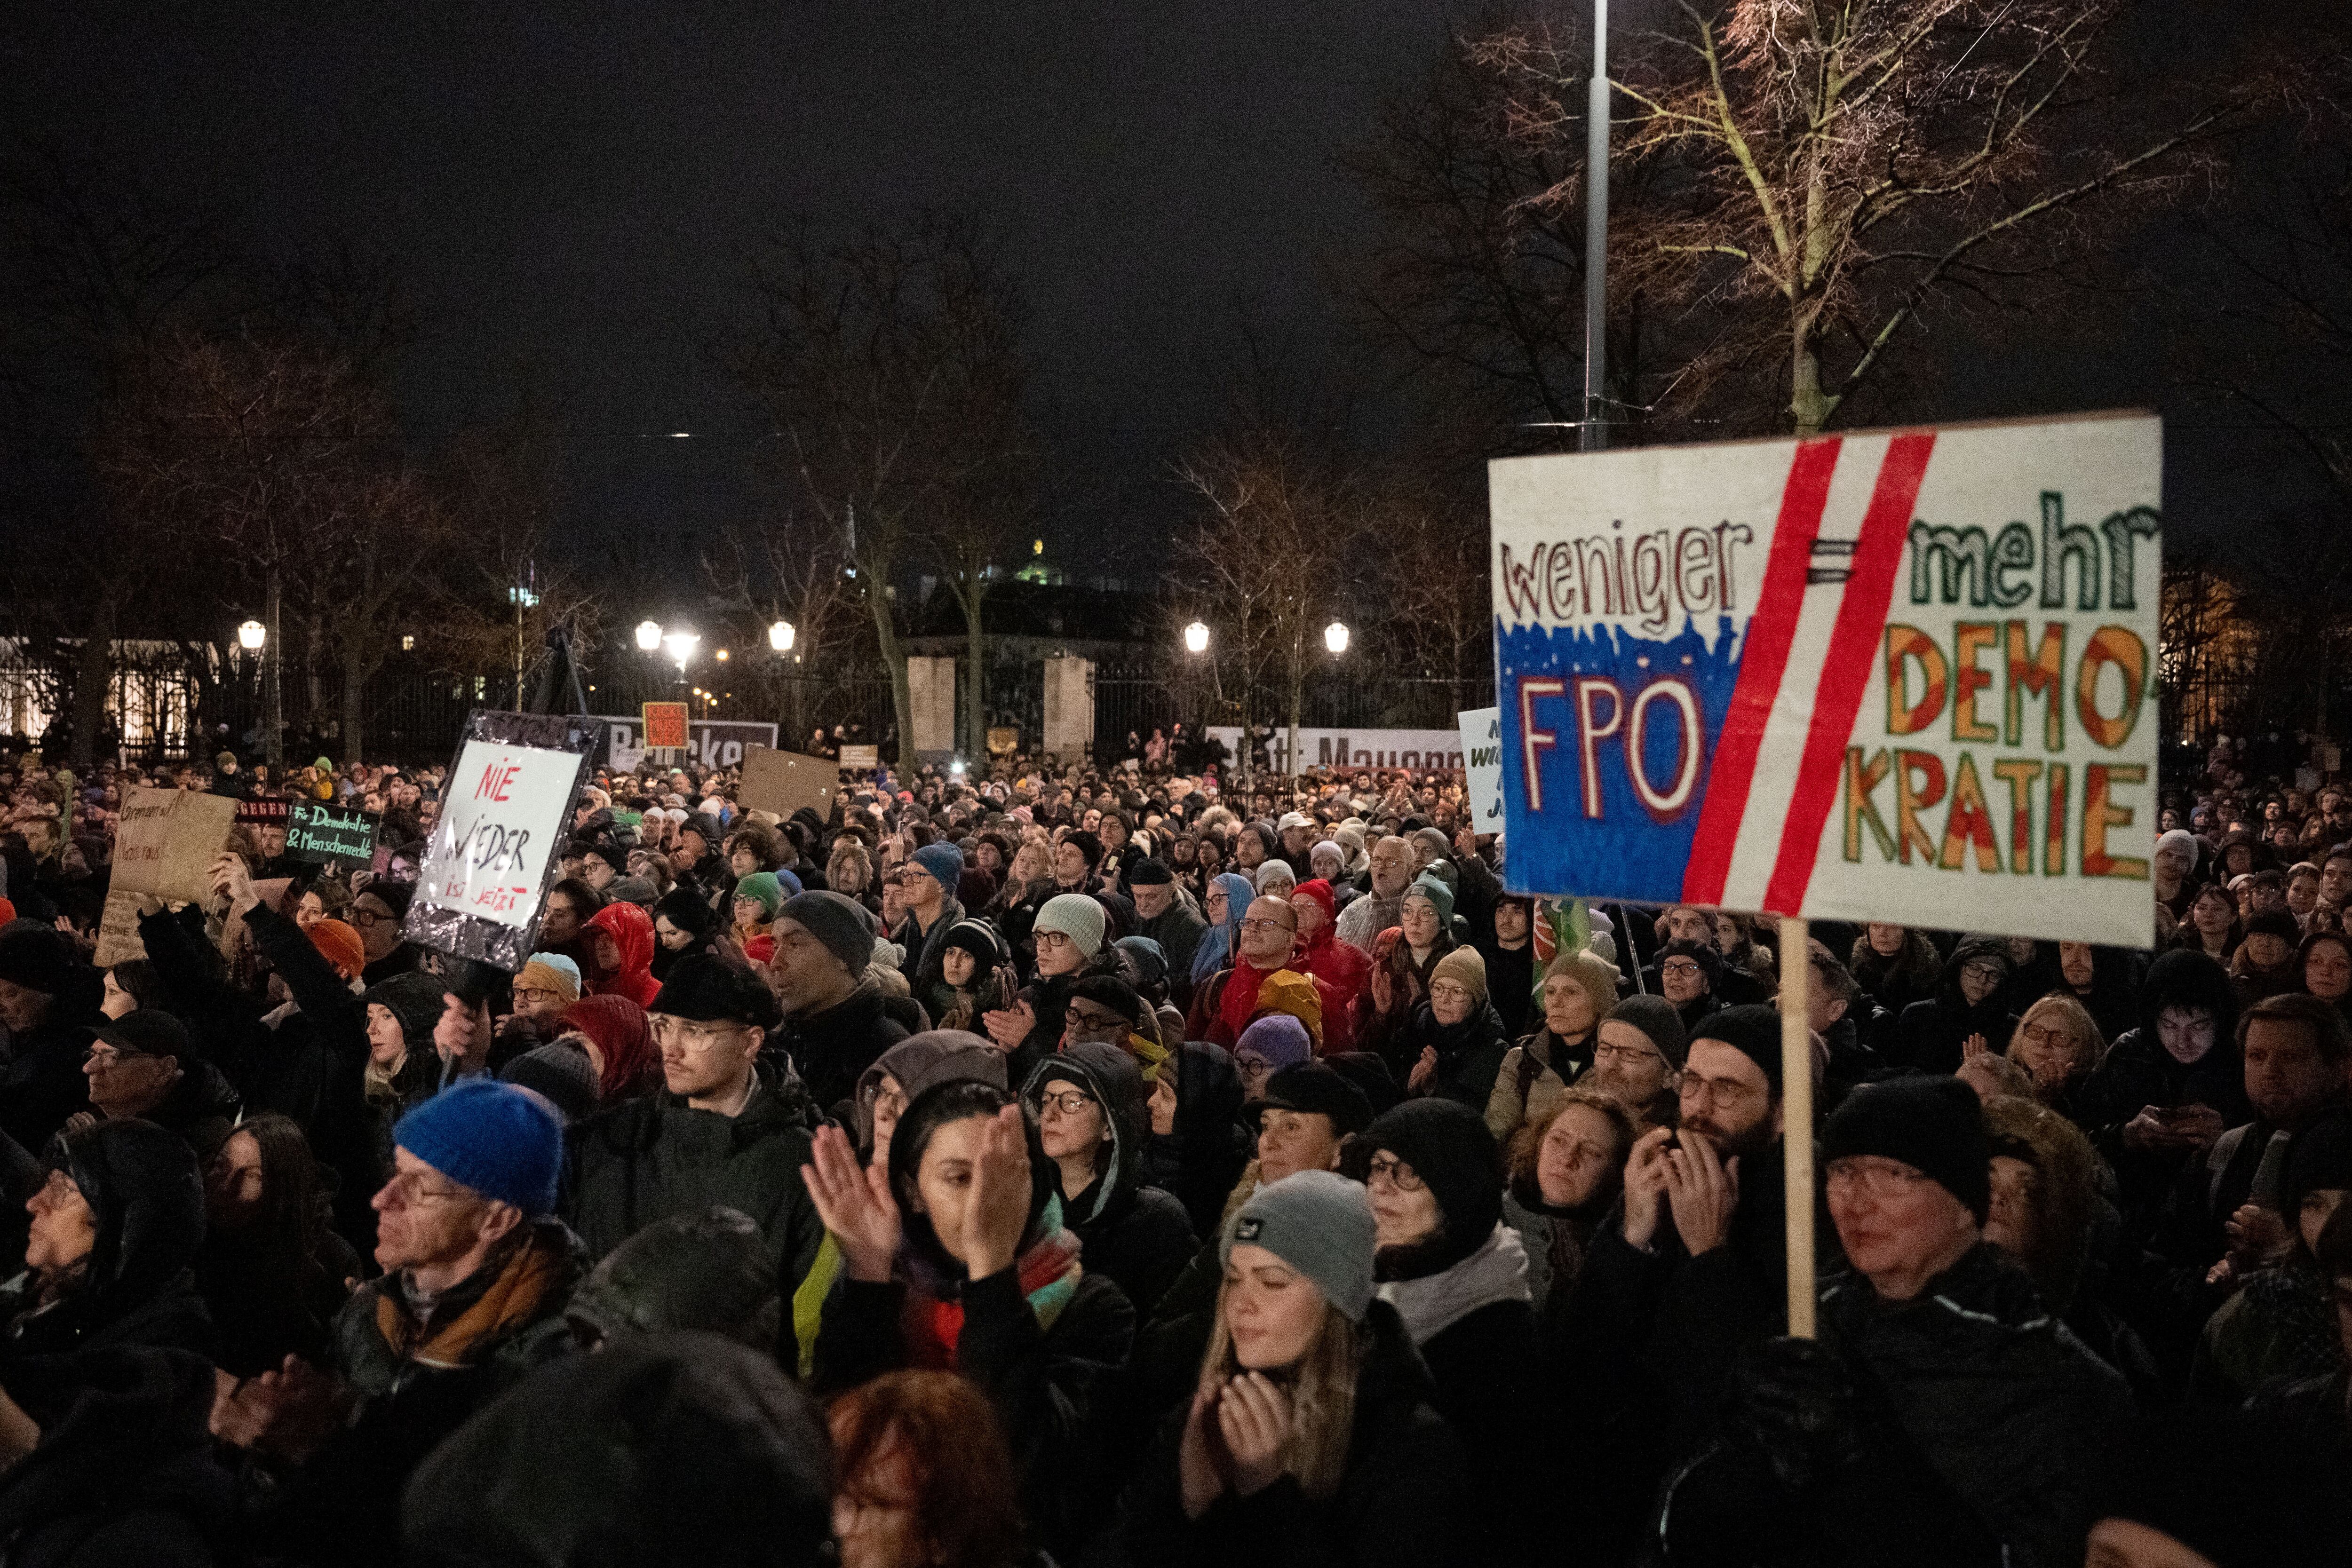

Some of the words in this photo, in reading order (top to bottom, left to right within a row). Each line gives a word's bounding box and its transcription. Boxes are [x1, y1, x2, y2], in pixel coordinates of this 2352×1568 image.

[1501, 520, 1752, 634] weniger
[1908, 490, 2160, 610] mehr
[650, 732, 682, 745] WEG
[1517, 655, 1704, 824] FPÖ
[240, 802, 286, 816] GEGEN
[310, 805, 371, 833] Demokratie
[1843, 746, 2150, 881] KRATIE
[286, 828, 300, 847] &
[301, 832, 373, 859] Menschenrechte
